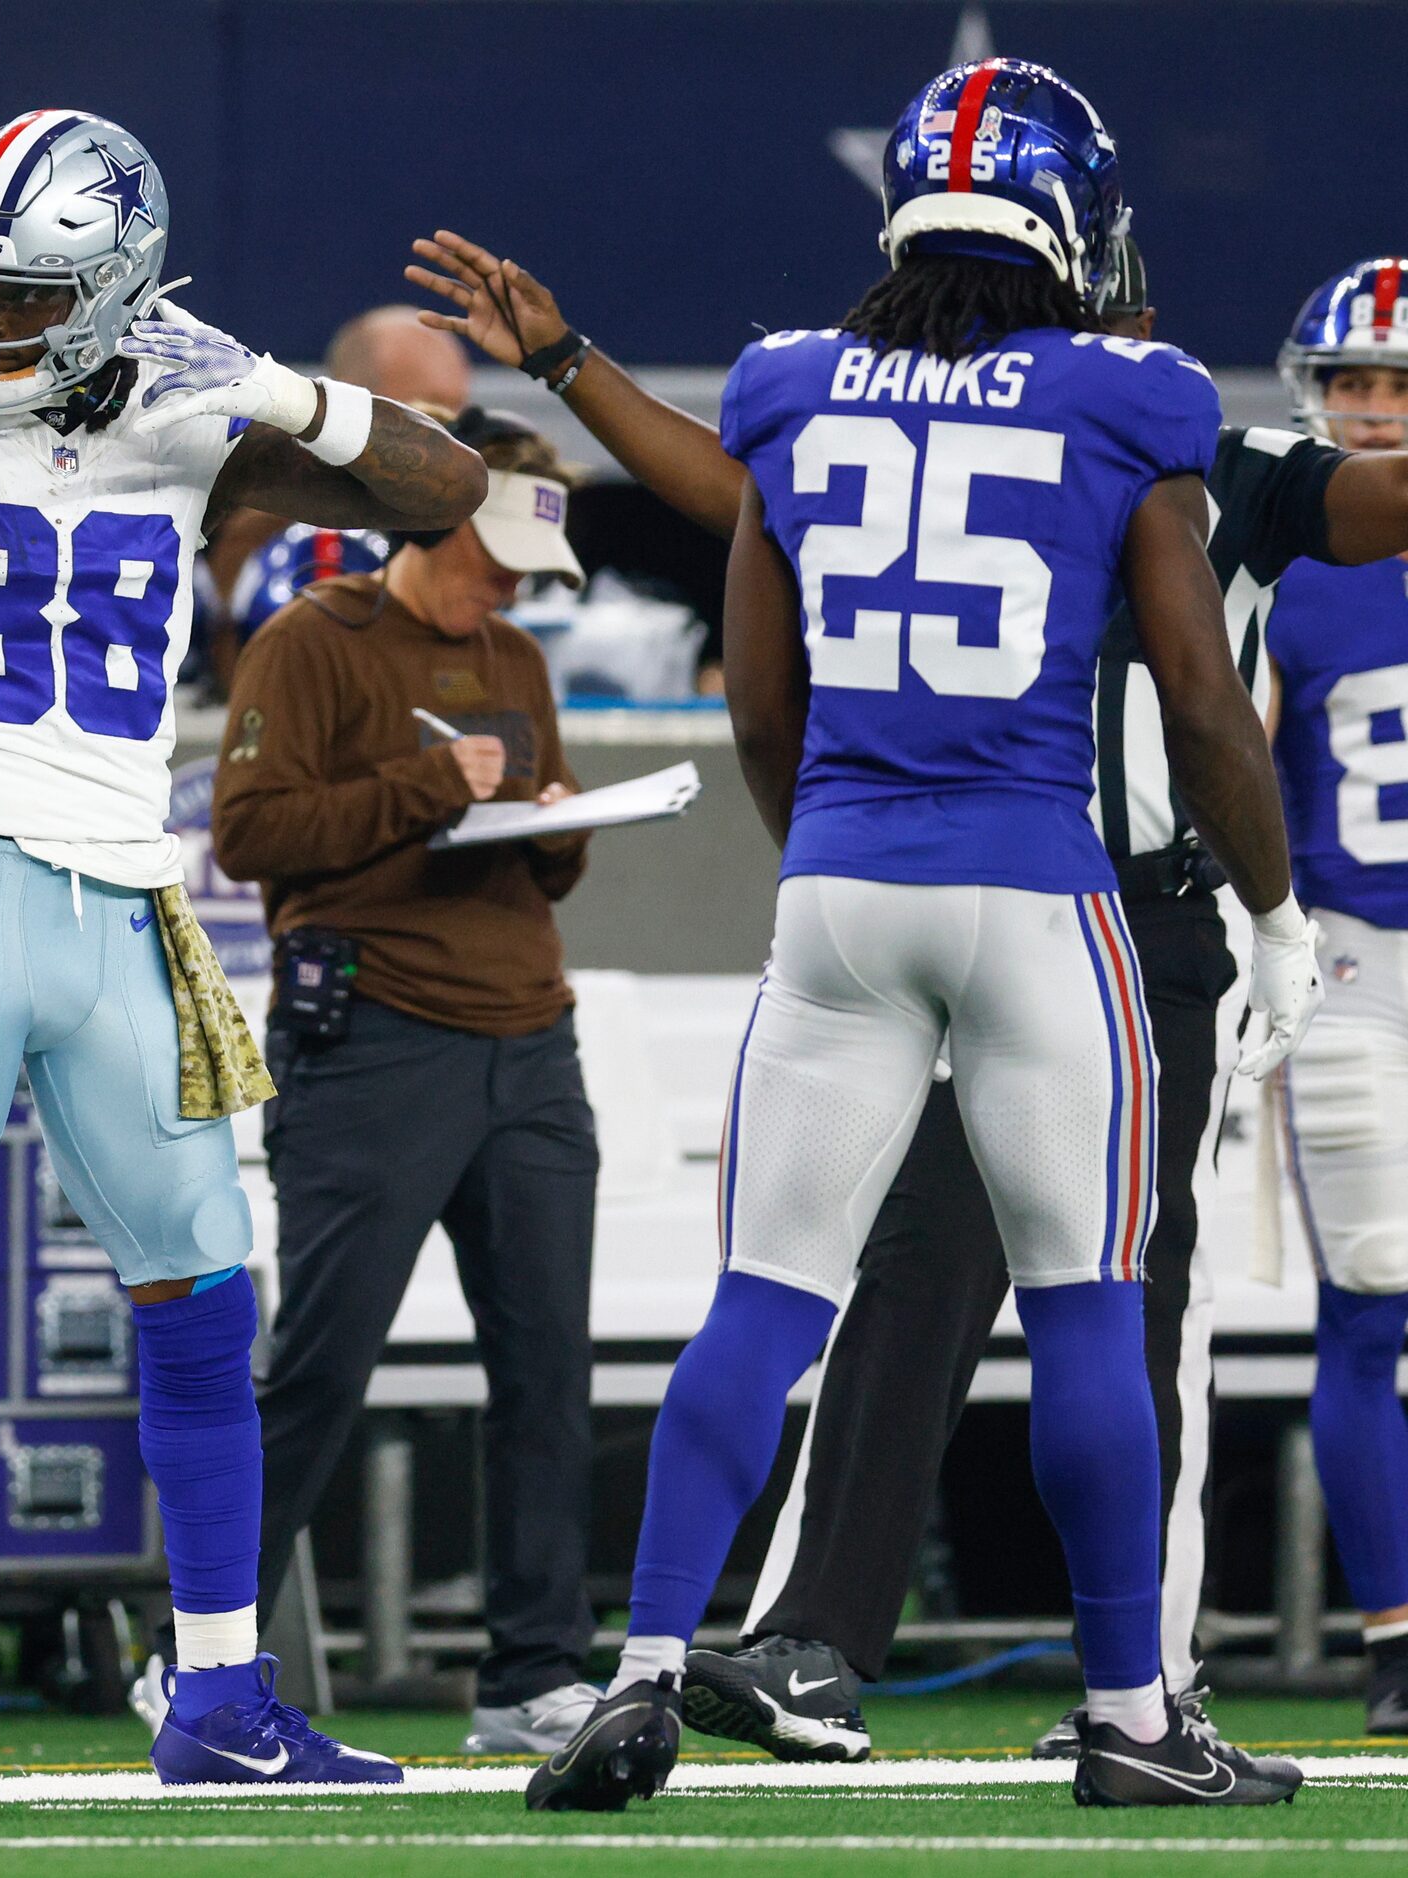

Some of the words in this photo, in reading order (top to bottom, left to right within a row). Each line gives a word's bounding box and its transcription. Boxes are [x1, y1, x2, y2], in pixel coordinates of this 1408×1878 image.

[927, 139, 996, 182] 25
[830, 346, 1034, 408] BANKS
[55, 456, 76, 471] NFL
[792, 413, 1066, 700] 25
